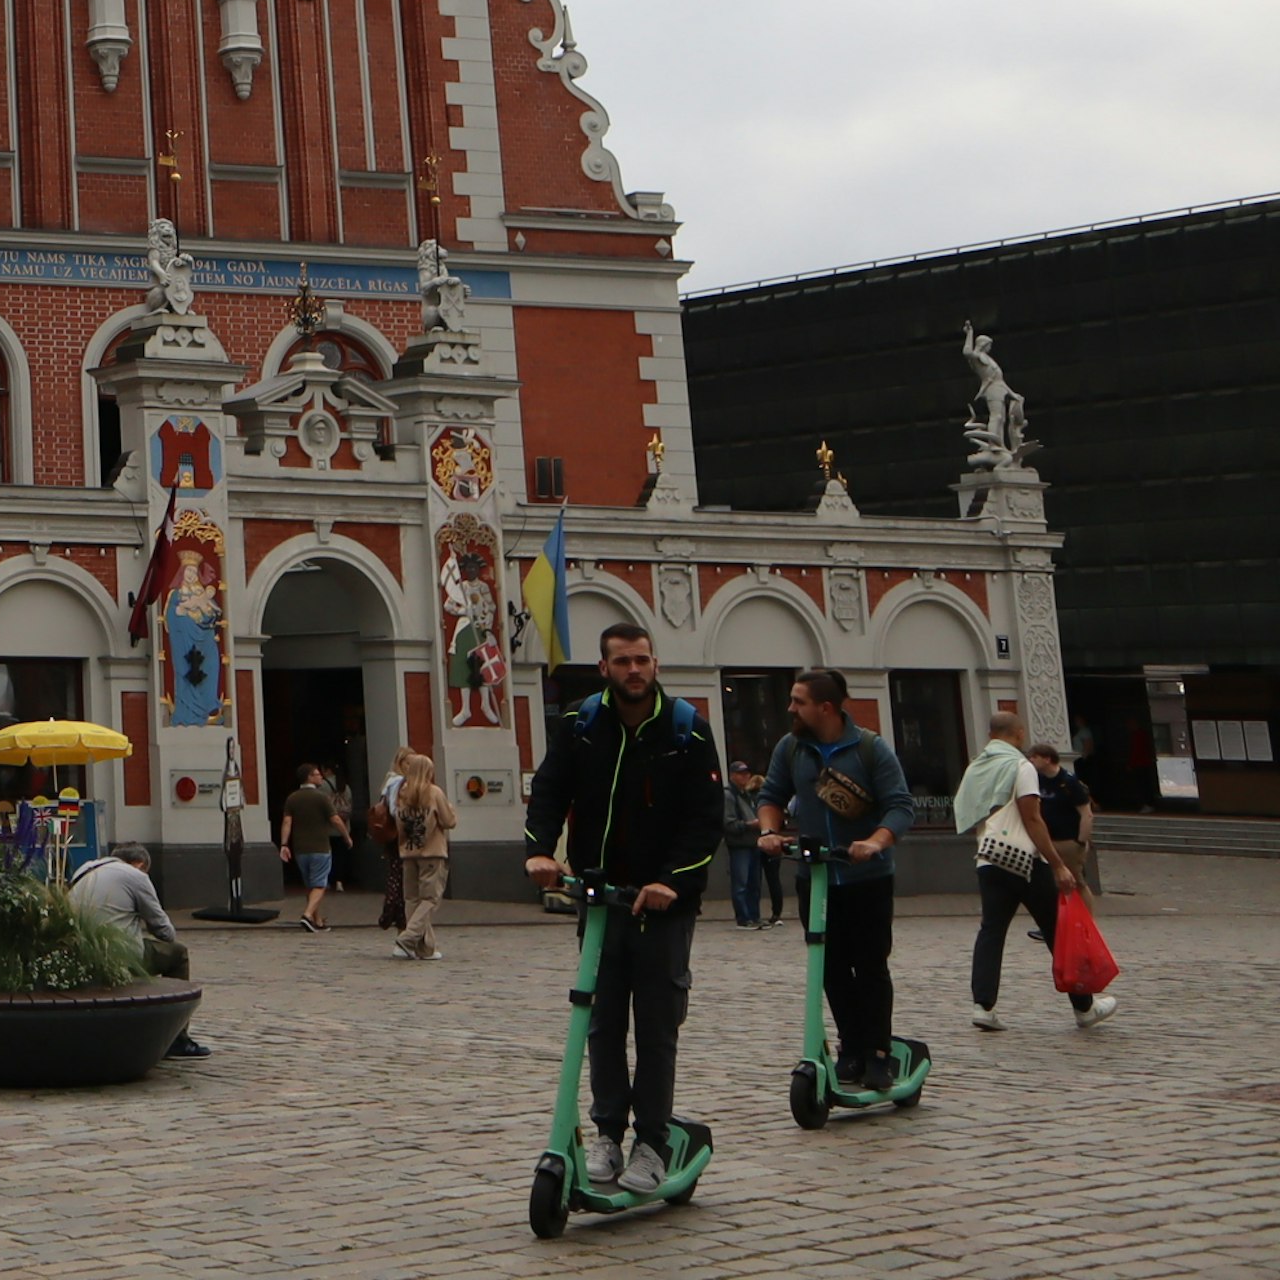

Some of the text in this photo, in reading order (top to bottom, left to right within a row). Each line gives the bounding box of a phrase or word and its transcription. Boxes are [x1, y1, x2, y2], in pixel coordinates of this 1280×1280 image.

[27, 252, 66, 264] NAMS
[72, 254, 106, 267] TIKA
[1, 264, 45, 276] NAMU
[53, 266, 73, 278] UZ
[80, 267, 149, 282] VECAJIEM
[233, 275, 254, 287] NO
[309, 276, 361, 292] UZCĒLA
